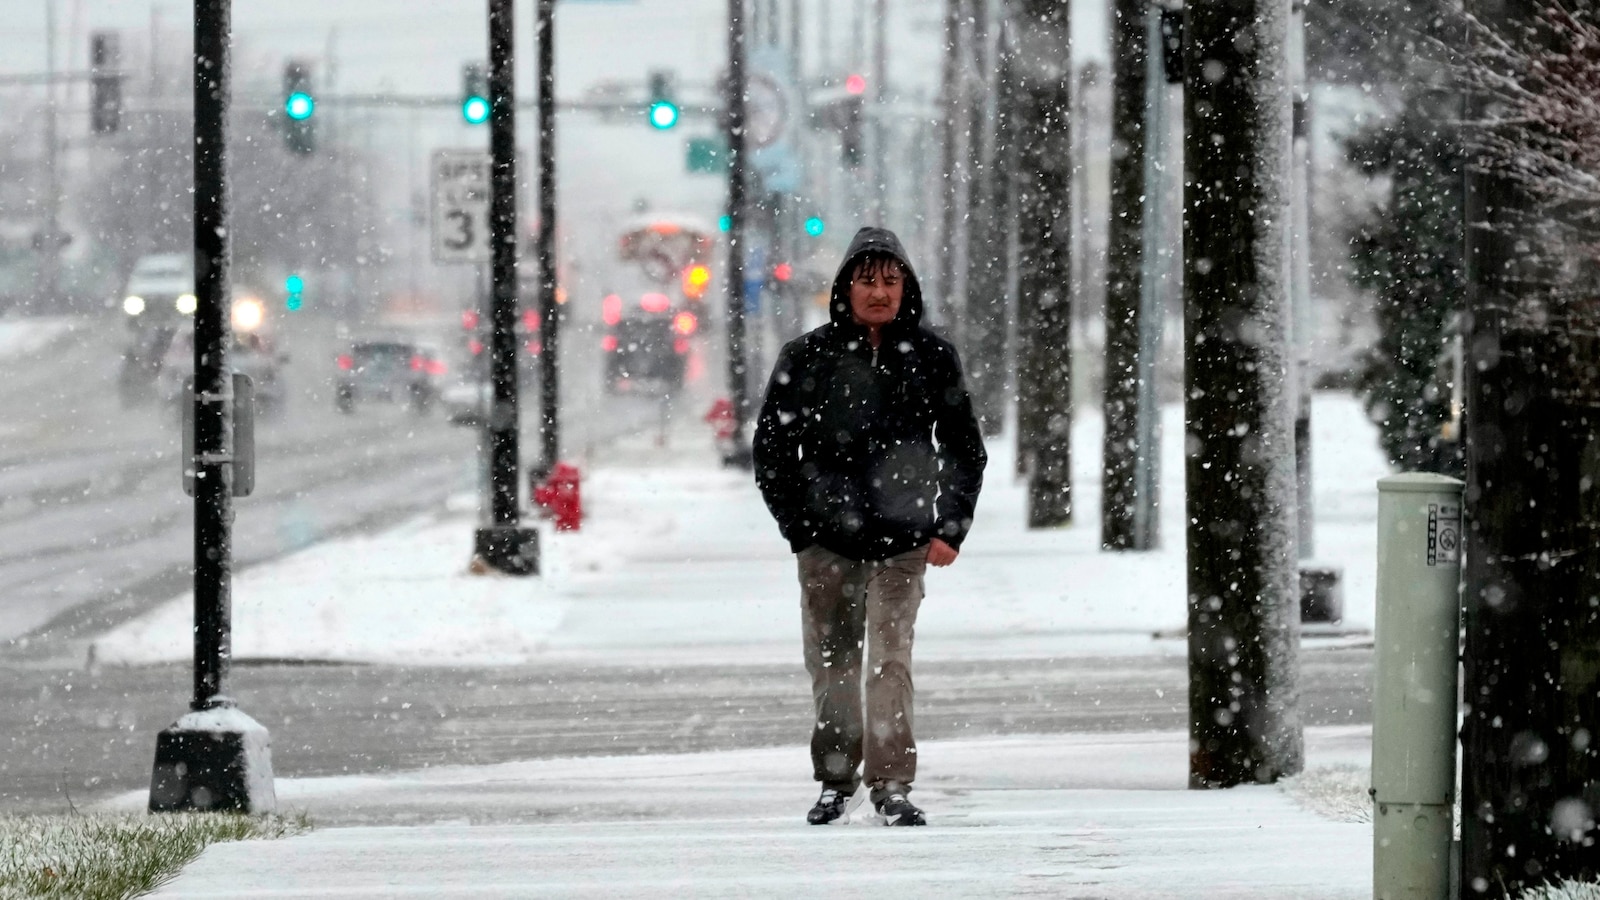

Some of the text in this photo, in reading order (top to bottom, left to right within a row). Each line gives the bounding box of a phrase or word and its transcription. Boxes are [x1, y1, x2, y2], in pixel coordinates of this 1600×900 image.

[440, 162, 485, 180] SPE
[443, 209, 475, 251] 3
[1428, 505, 1437, 566] WARNING
